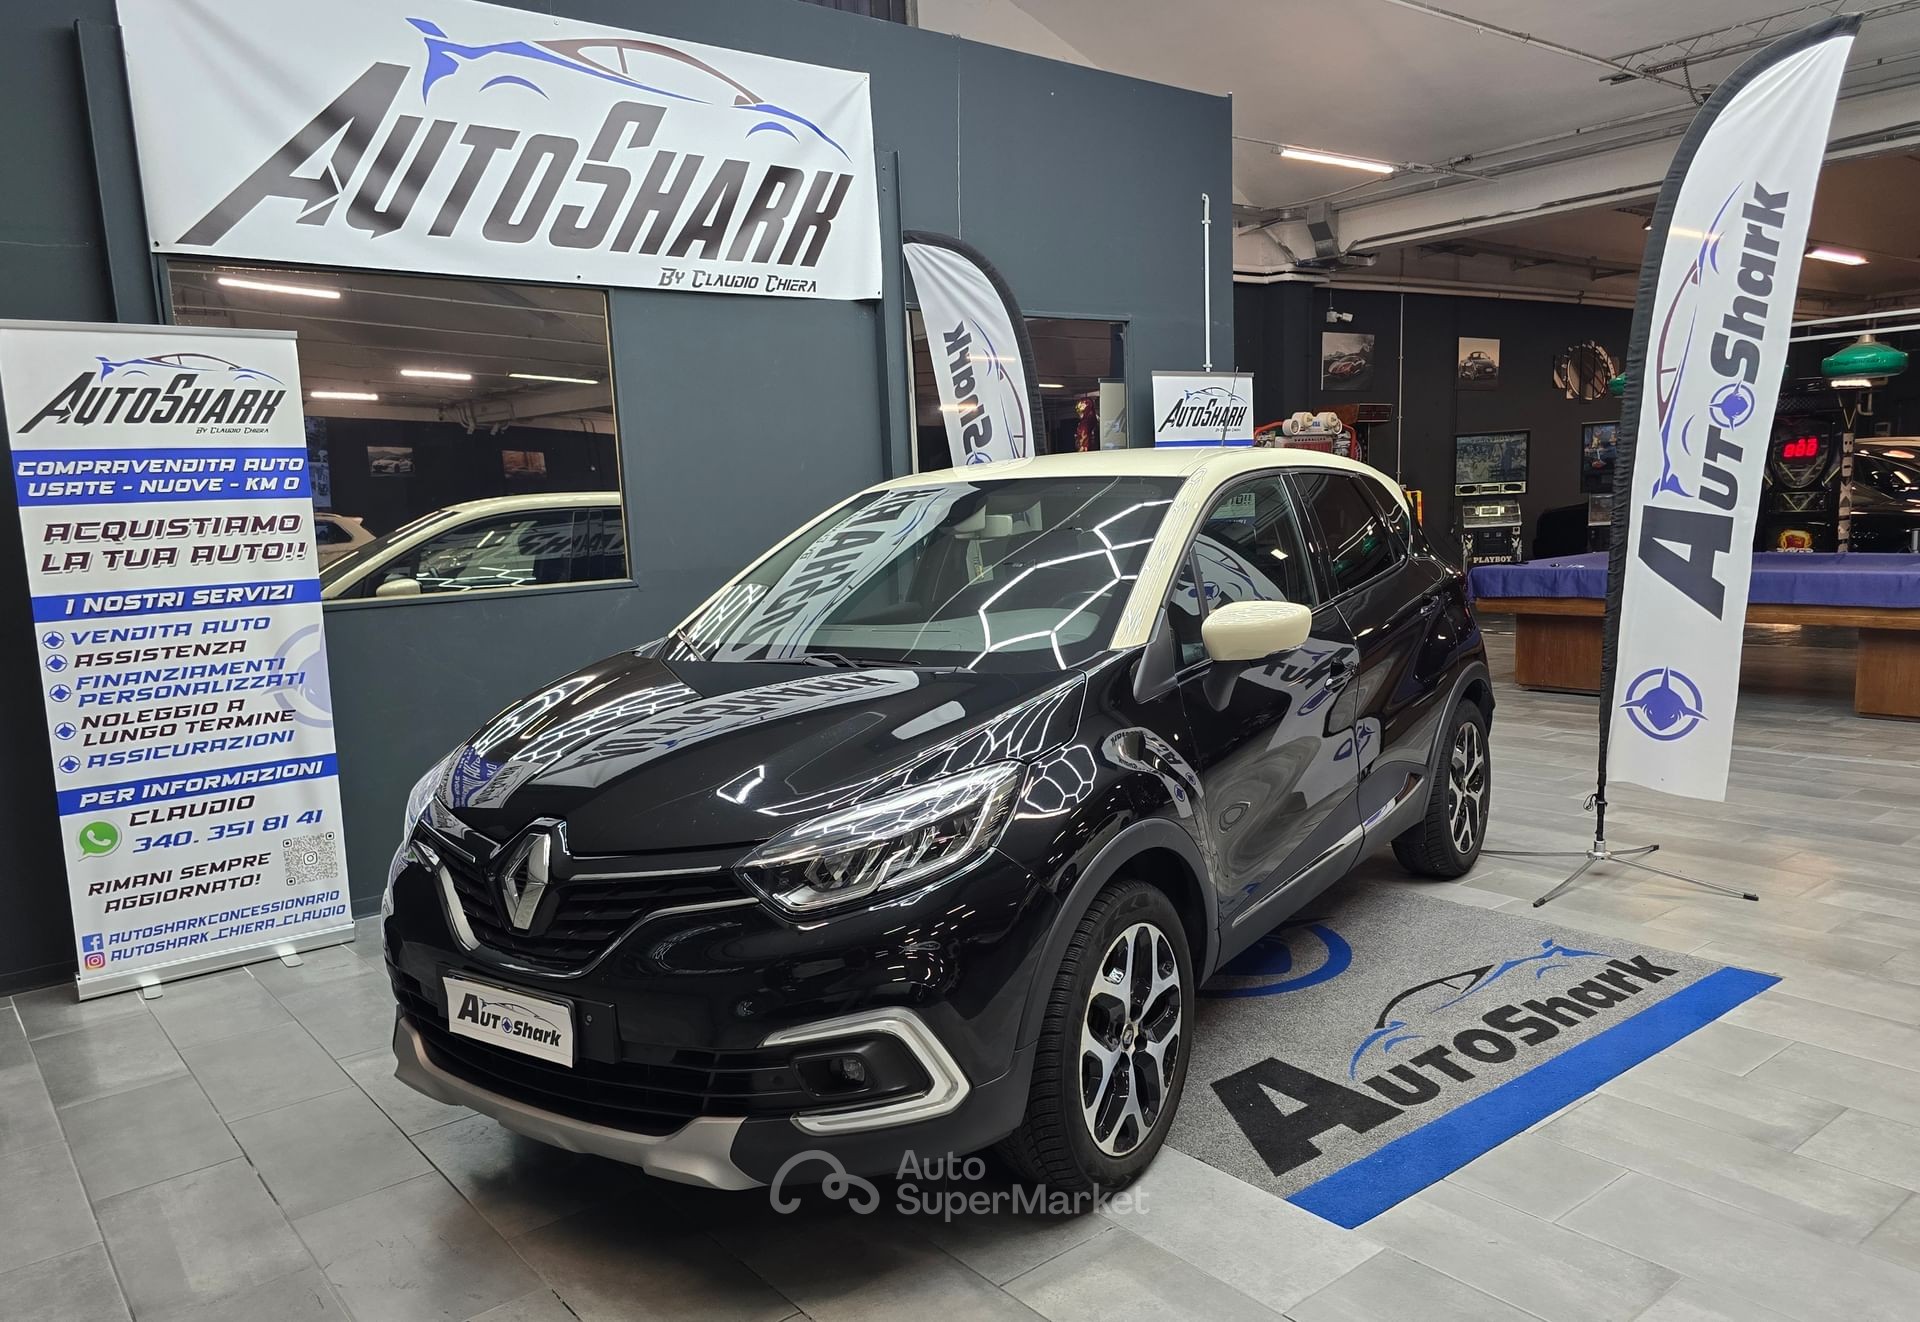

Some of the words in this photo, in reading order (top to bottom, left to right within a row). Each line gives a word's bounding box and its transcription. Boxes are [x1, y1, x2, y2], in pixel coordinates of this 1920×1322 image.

[175, 61, 854, 268] AUTOSHARK
[658, 267, 686, 287] BY
[691, 269, 760, 289] CLAUDIO
[765, 274, 817, 293] CHIERA
[16, 371, 288, 434] AUTOSHARK
[17, 458, 236, 477] COMPRAVENDITA
[243, 457, 305, 471] AUTO
[28, 480, 116, 497] USATE
[139, 478, 224, 494] NUOVE
[245, 477, 277, 492] KM
[43, 514, 303, 546] ACQUISTIAMO
[41, 551, 92, 574] LA
[102, 547, 178, 570] TUA
[190, 541, 307, 563] AUTO!!
[1473, 556, 1512, 564] PLAYBOY
[64, 599, 74, 615] I
[83, 592, 184, 614] NOSTRI
[192, 584, 293, 605] SERVIZI
[71, 622, 193, 646] VENDITA
[201, 617, 271, 634] AUTO
[74, 640, 247, 668] ASSISTENZA
[75, 657, 286, 690] FINANZIAMENTI
[78, 672, 306, 708] PERSONALIZZATI
[80, 702, 218, 730] NOLEGGIO
[227, 699, 245, 712] A
[83, 723, 177, 747] LUNGO
[186, 709, 296, 735] TERMINE
[87, 730, 296, 769] ASSICURAZIONI
[78, 788, 134, 808] PER
[141, 761, 323, 799] INFORMAZIONI
[129, 795, 255, 827] CLAUDIO
[206, 820, 255, 842] 351
[262, 814, 288, 832] 81
[296, 809, 323, 825] 41
[87, 869, 172, 897] RIMANI
[180, 852, 272, 879] SEMPRE
[104, 873, 262, 914] AGGIORNATO!
[108, 889, 341, 946] AUTOSHARKCONCESSIONARIO
[110, 903, 347, 962] AUTOSHARK_CHIERA_CLAUDIO
